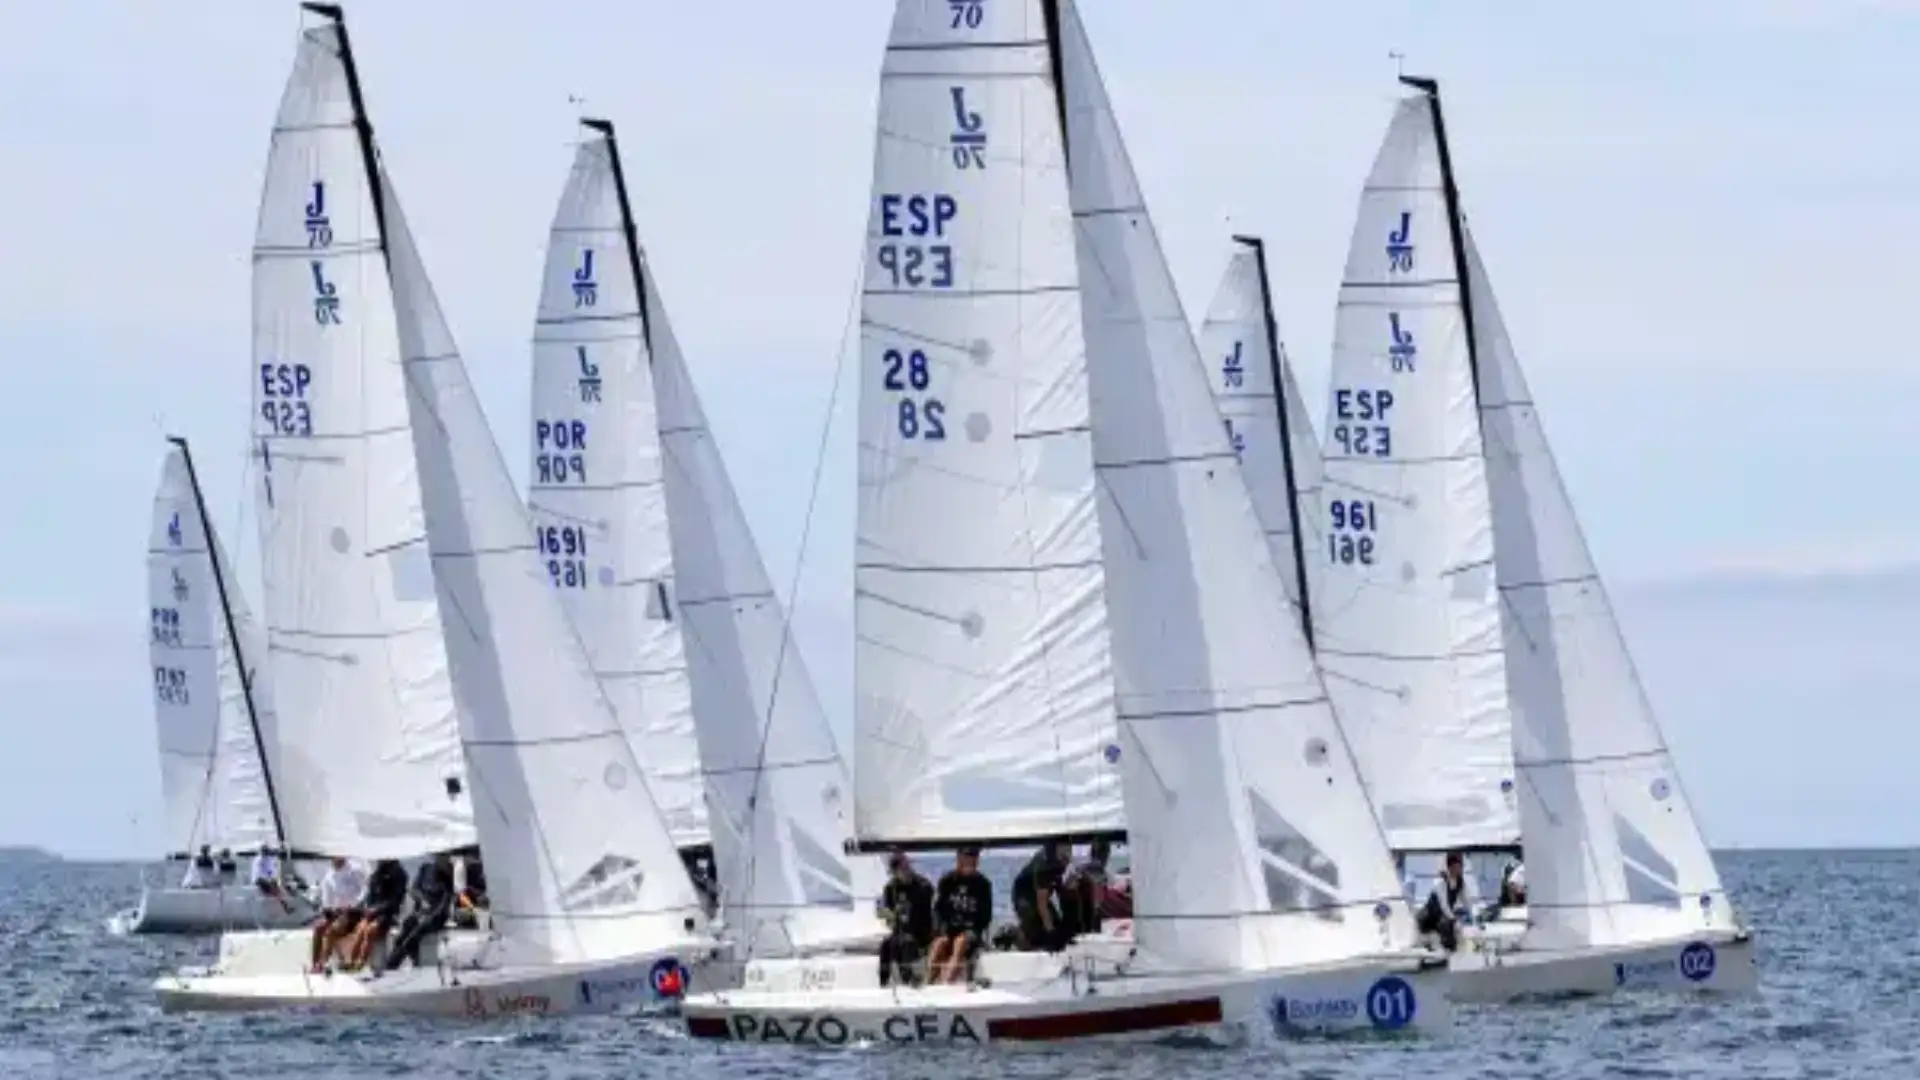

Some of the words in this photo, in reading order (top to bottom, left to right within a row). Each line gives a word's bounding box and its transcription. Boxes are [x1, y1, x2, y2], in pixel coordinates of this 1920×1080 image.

[949, 5, 983, 29] 70
[305, 181, 325, 217] J
[881, 194, 958, 237] ESP
[1389, 212, 1412, 243] J
[306, 227, 333, 248] 70
[575, 249, 594, 281] J
[261, 364, 311, 398] ESP
[882, 349, 930, 391] 28
[1335, 389, 1394, 421] ESP
[536, 420, 586, 450] POR
[1329, 500, 1377, 532] 961
[536, 525, 586, 557] 1691
[1683, 950, 1711, 975] 02
[1372, 987, 1407, 1021] 01
[733, 1014, 848, 1045] PAZO
